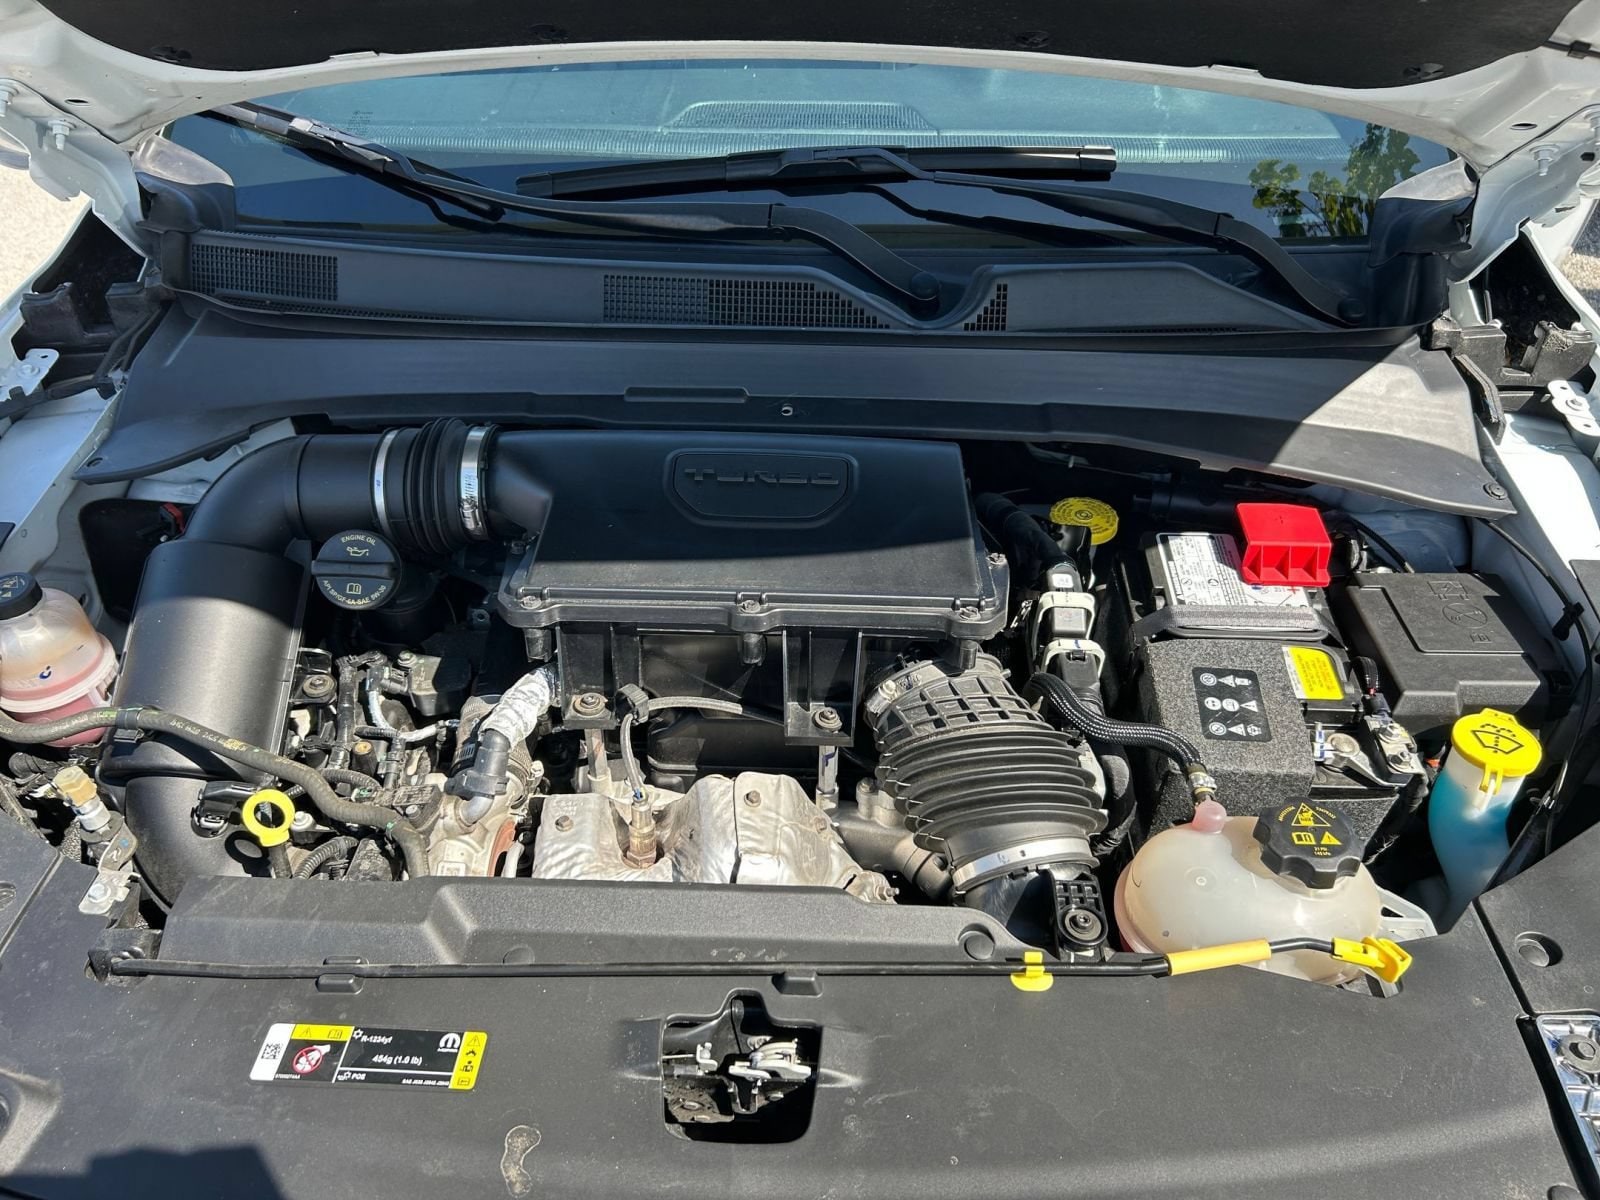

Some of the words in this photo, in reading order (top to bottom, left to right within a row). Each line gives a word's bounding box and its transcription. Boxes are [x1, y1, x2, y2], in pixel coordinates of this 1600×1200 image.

[684, 468, 839, 486] TURBO
[341, 534, 366, 543] ENGINE
[366, 536, 376, 546] OIL
[372, 1054, 394, 1065] 454g
